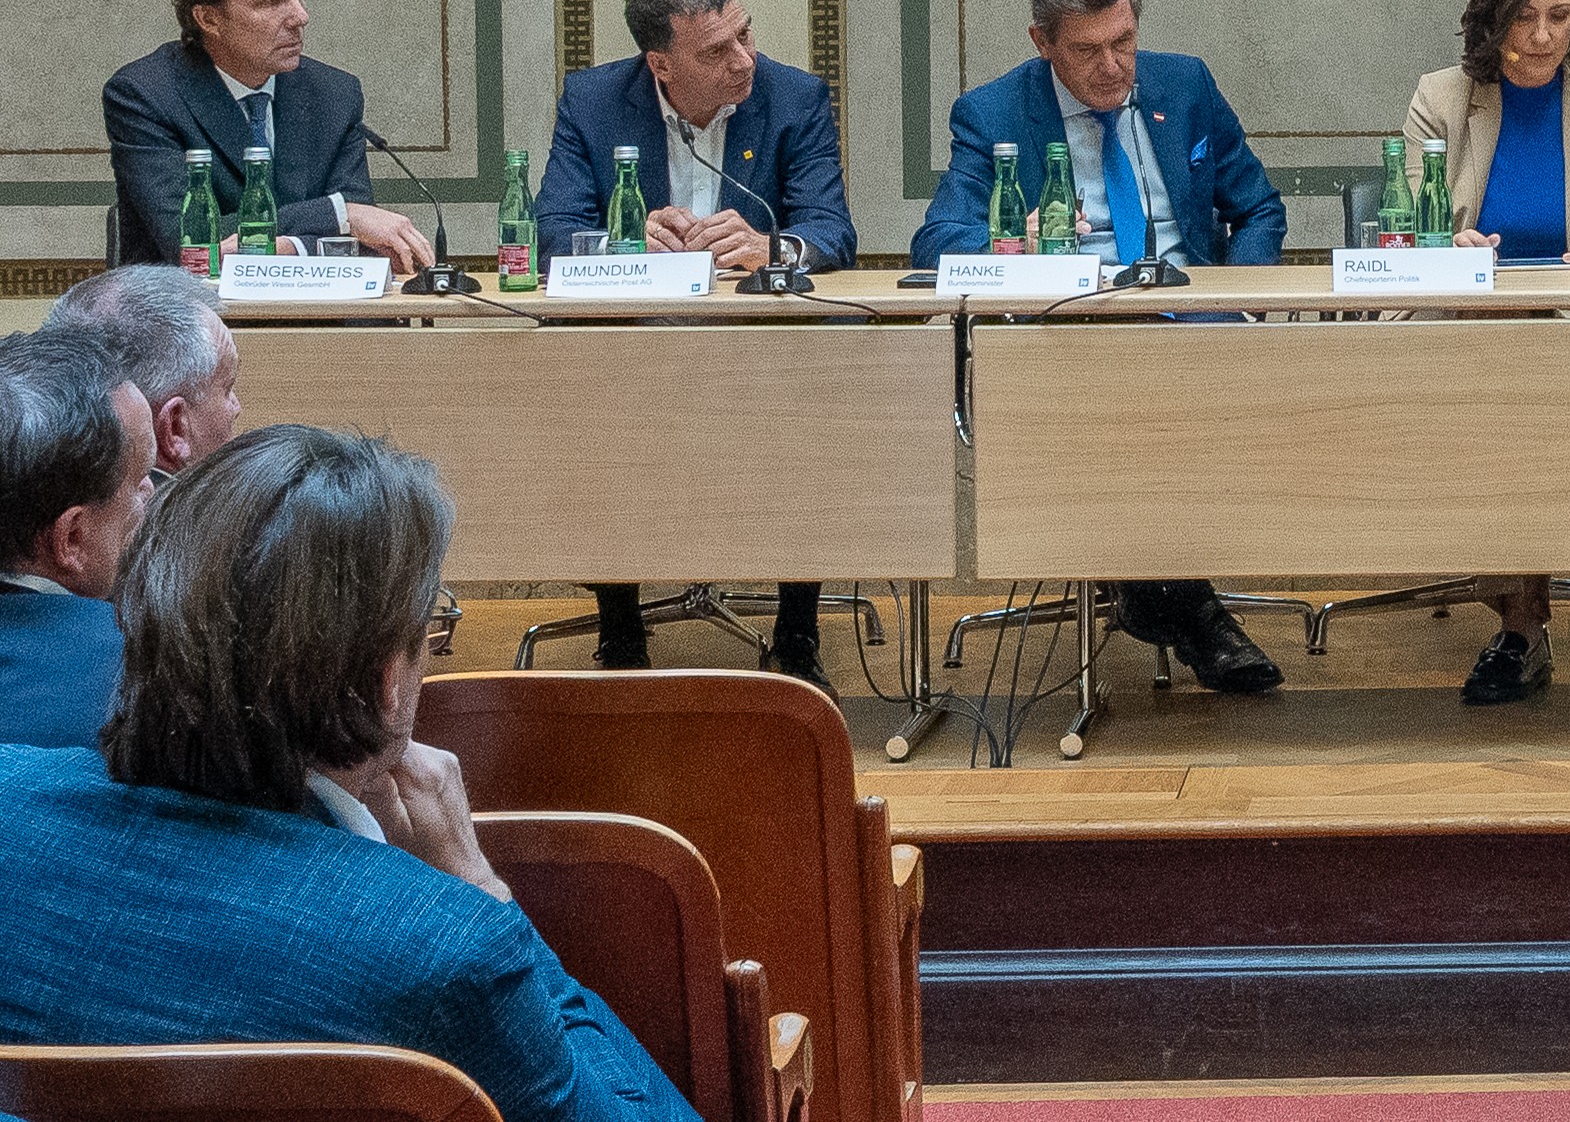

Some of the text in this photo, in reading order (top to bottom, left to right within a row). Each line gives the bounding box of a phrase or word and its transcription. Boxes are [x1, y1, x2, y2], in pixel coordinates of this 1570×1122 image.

[233, 264, 364, 279] SENGER-WEISS
[561, 264, 648, 278] UMUNDUM
[949, 265, 1005, 278] HANKE
[1344, 259, 1392, 273] RAIDL
